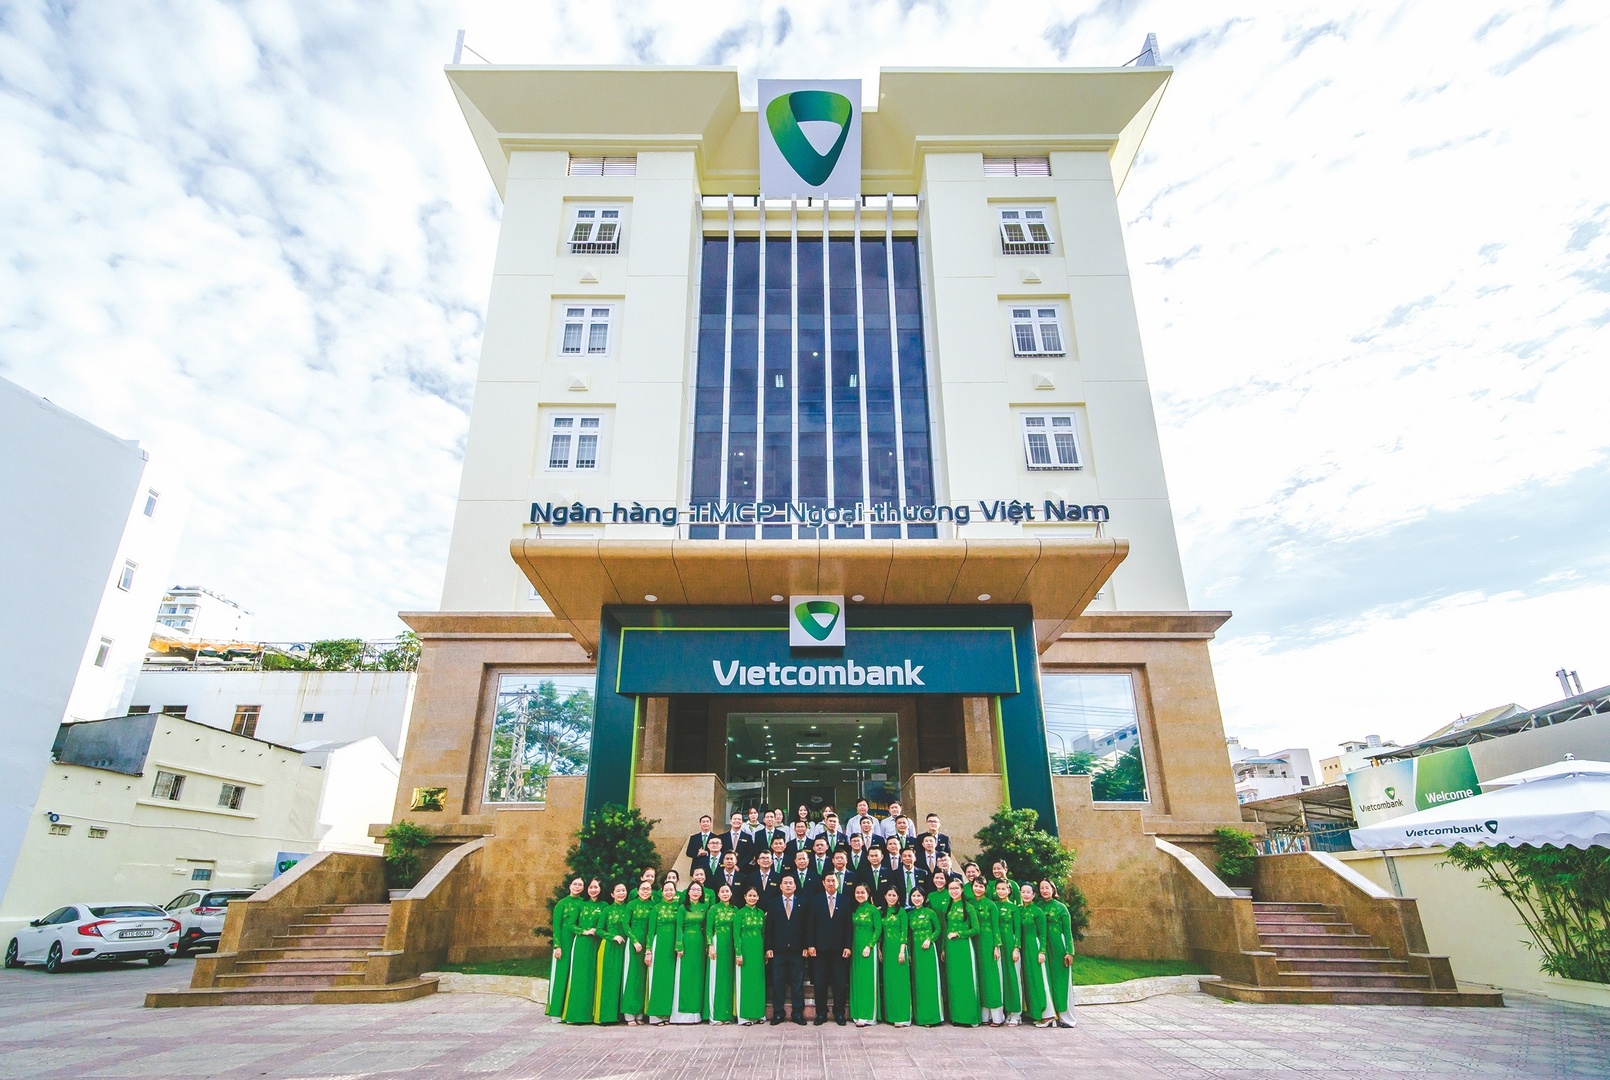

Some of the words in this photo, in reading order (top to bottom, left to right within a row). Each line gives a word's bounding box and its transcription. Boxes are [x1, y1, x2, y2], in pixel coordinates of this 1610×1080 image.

[530, 501, 602, 526] Ngân
[612, 501, 677, 526] hàng
[689, 502, 776, 523] TMCP
[786, 502, 864, 526] Ngoại
[874, 502, 970, 525] thương
[979, 499, 1035, 525] Việt
[1045, 499, 1110, 522] Nam
[712, 659, 926, 686] Vietcombank
[1425, 788, 1474, 804] Welcome
[1359, 799, 1404, 813] Vietcombank
[1405, 823, 1484, 837] Vietcombank
